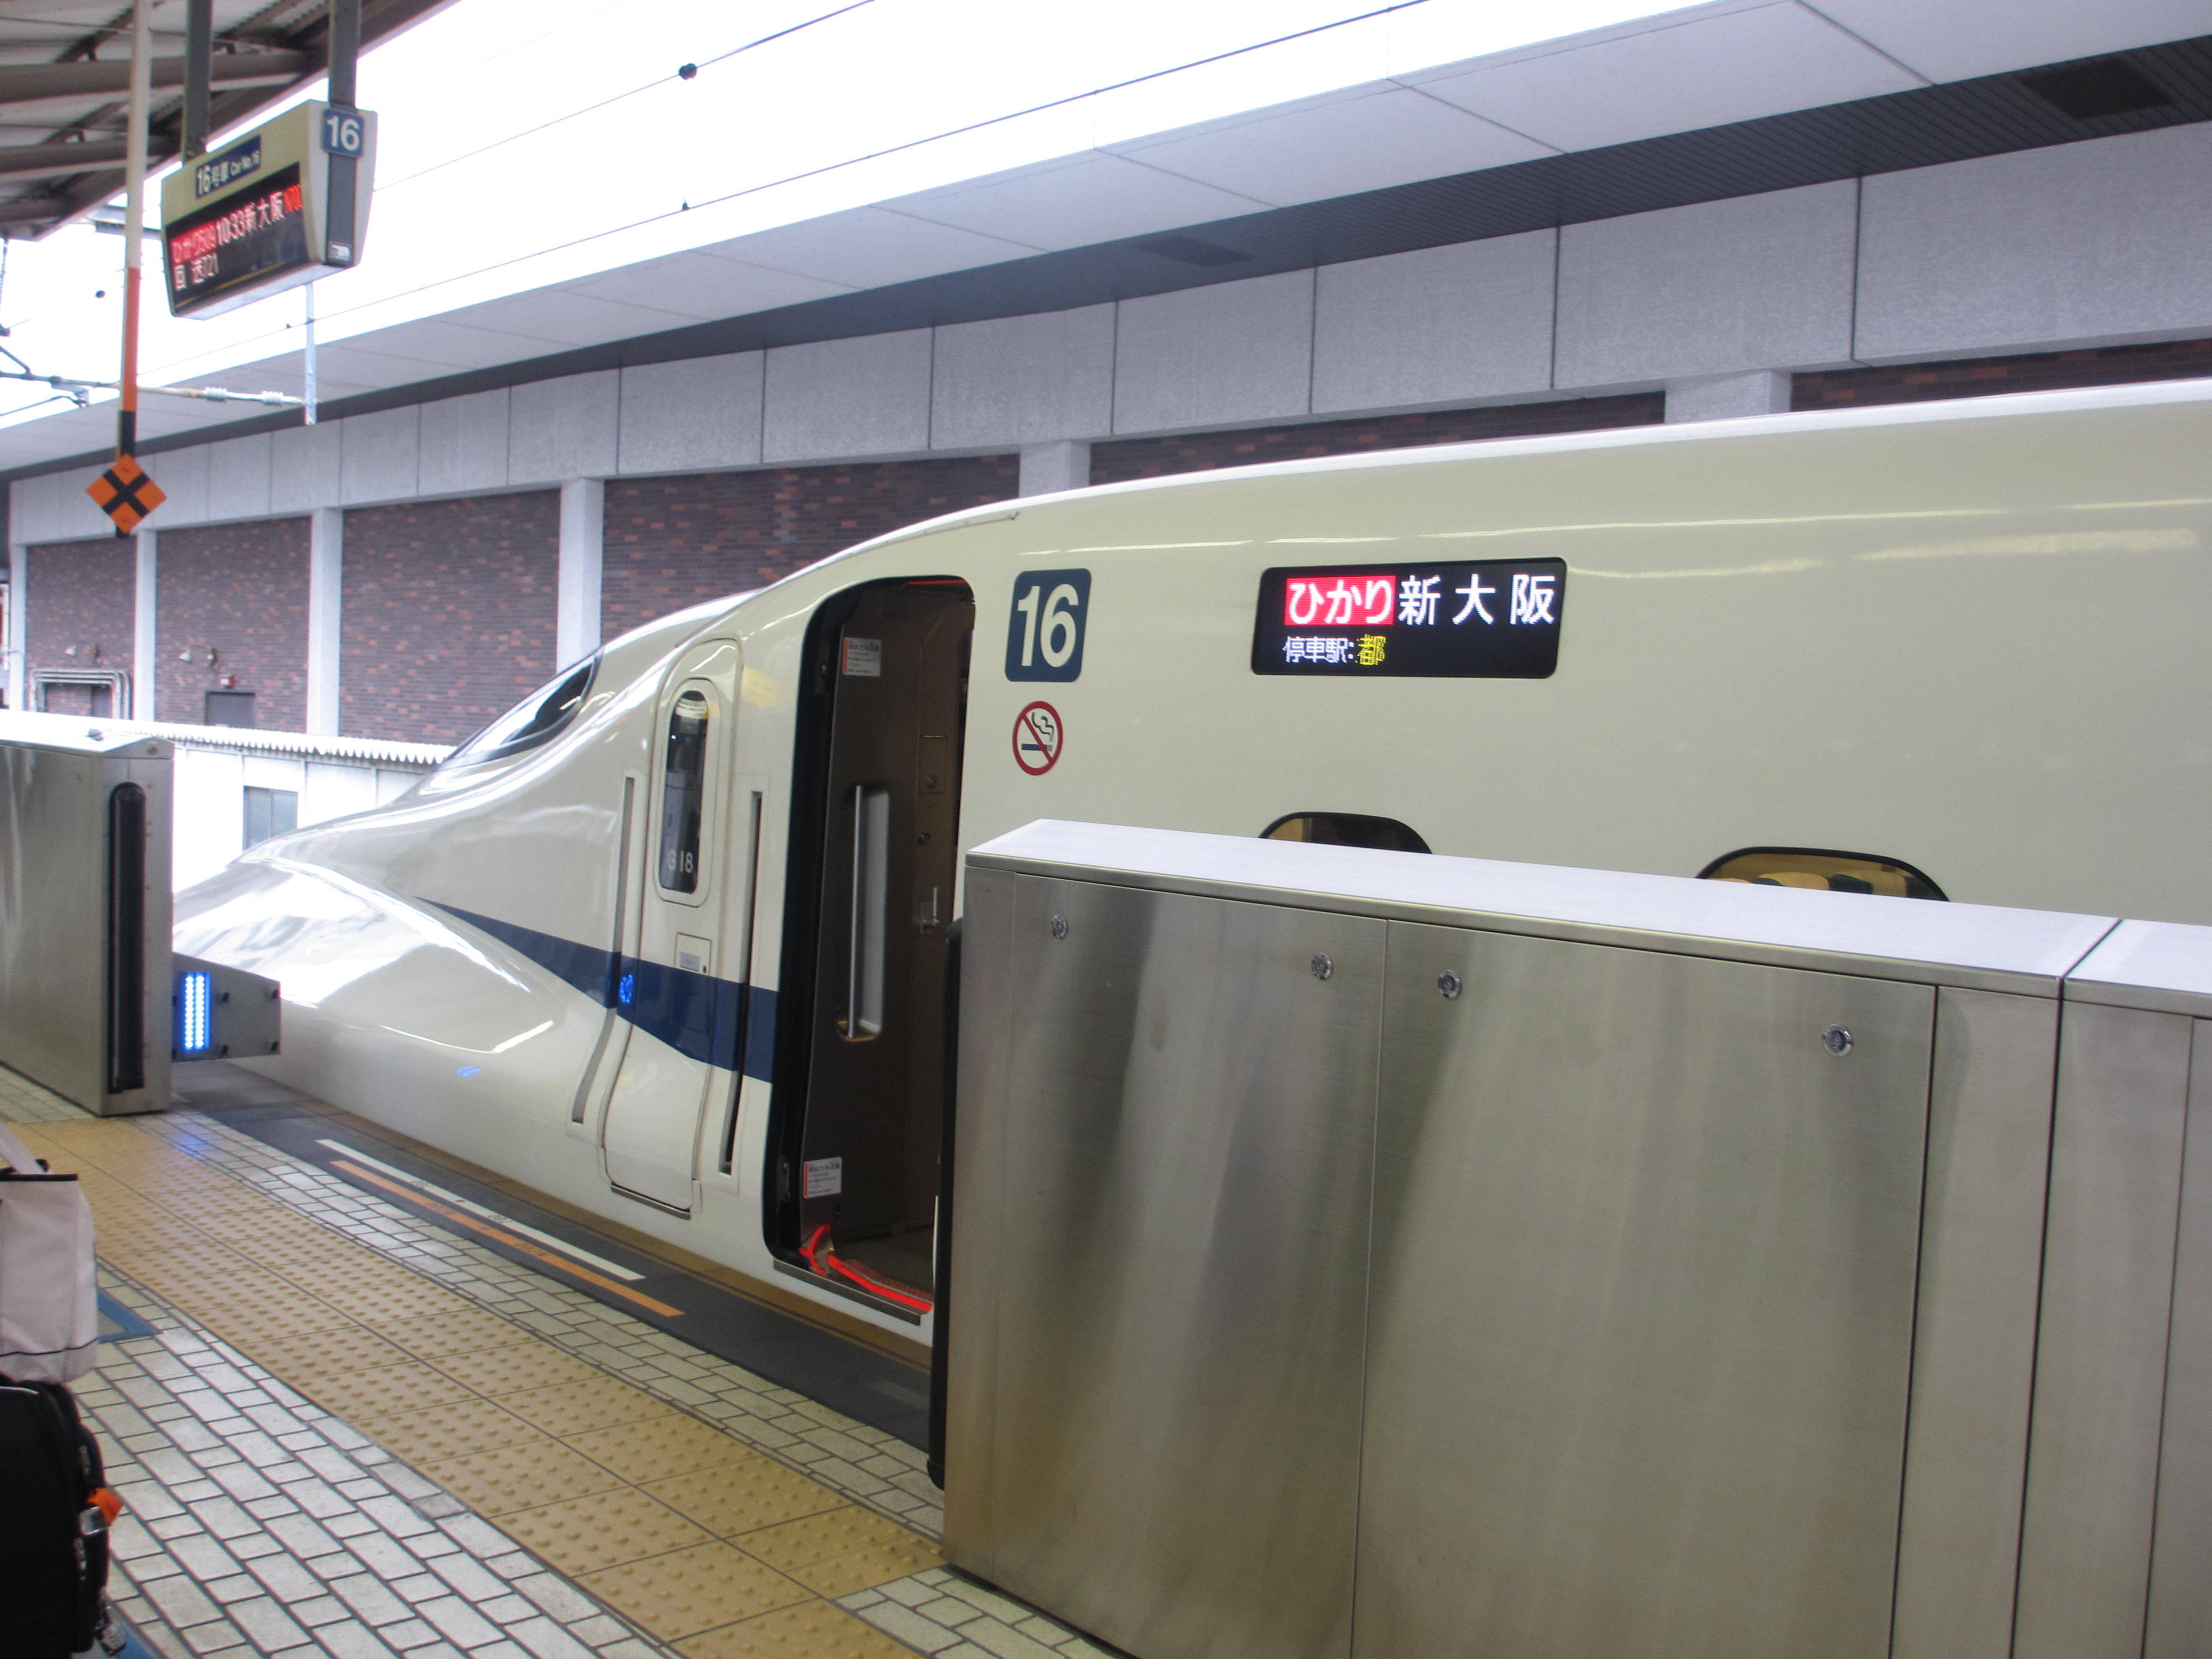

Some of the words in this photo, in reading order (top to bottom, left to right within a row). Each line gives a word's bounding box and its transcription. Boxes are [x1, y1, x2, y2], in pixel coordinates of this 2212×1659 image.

[326, 115, 359, 152] 16
[1017, 583, 1079, 667] 16
[1288, 579, 1392, 624] ひかり
[1397, 573, 1556, 625] 新大阪
